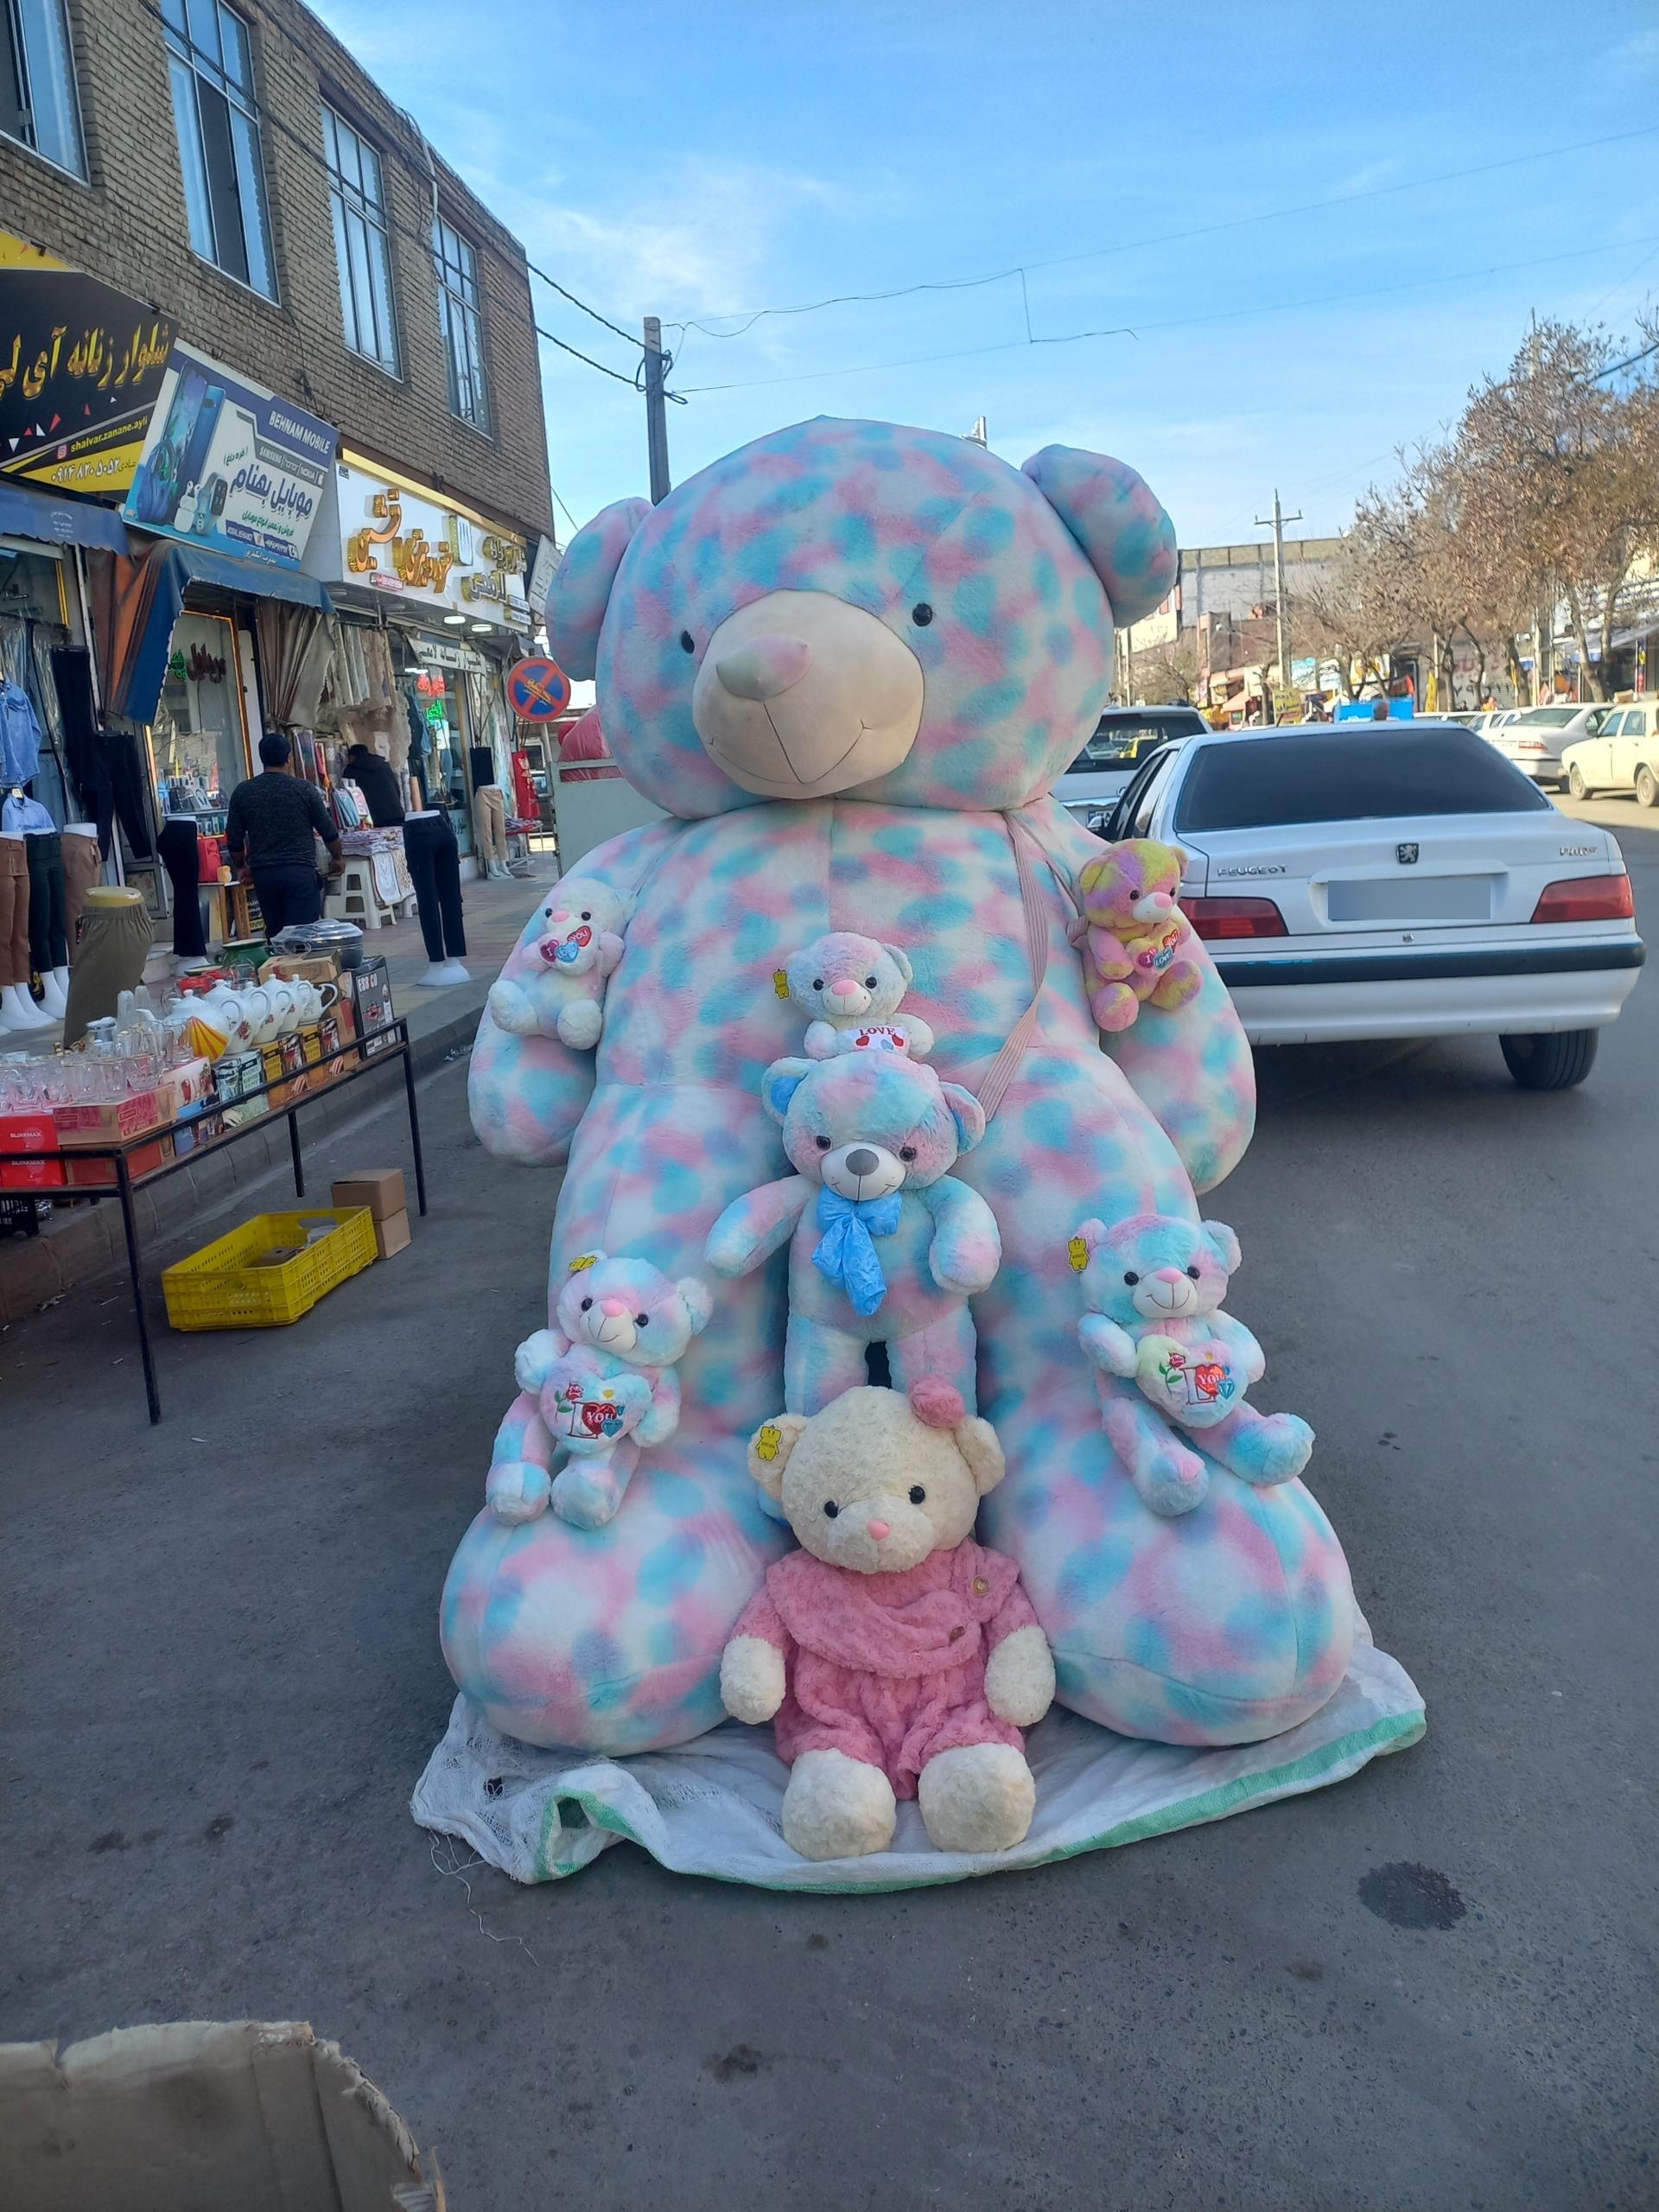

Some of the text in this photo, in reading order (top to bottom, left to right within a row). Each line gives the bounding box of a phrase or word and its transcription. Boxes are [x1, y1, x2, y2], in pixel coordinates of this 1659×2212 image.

[67, 327, 116, 391] زنانه
[114, 321, 171, 386] شلوار
[70, 415, 148, 452] shalvar.zanane.ayli
[269, 410, 331, 454] BEHNAM MOBILE
[228, 464, 313, 521] موبایل بهنام
[1217, 864, 1287, 877] PEUGEOT
[859, 1027, 895, 1037] LOVE
[1197, 1373, 1225, 1385] YOU
[587, 1411, 613, 1423] YOU
